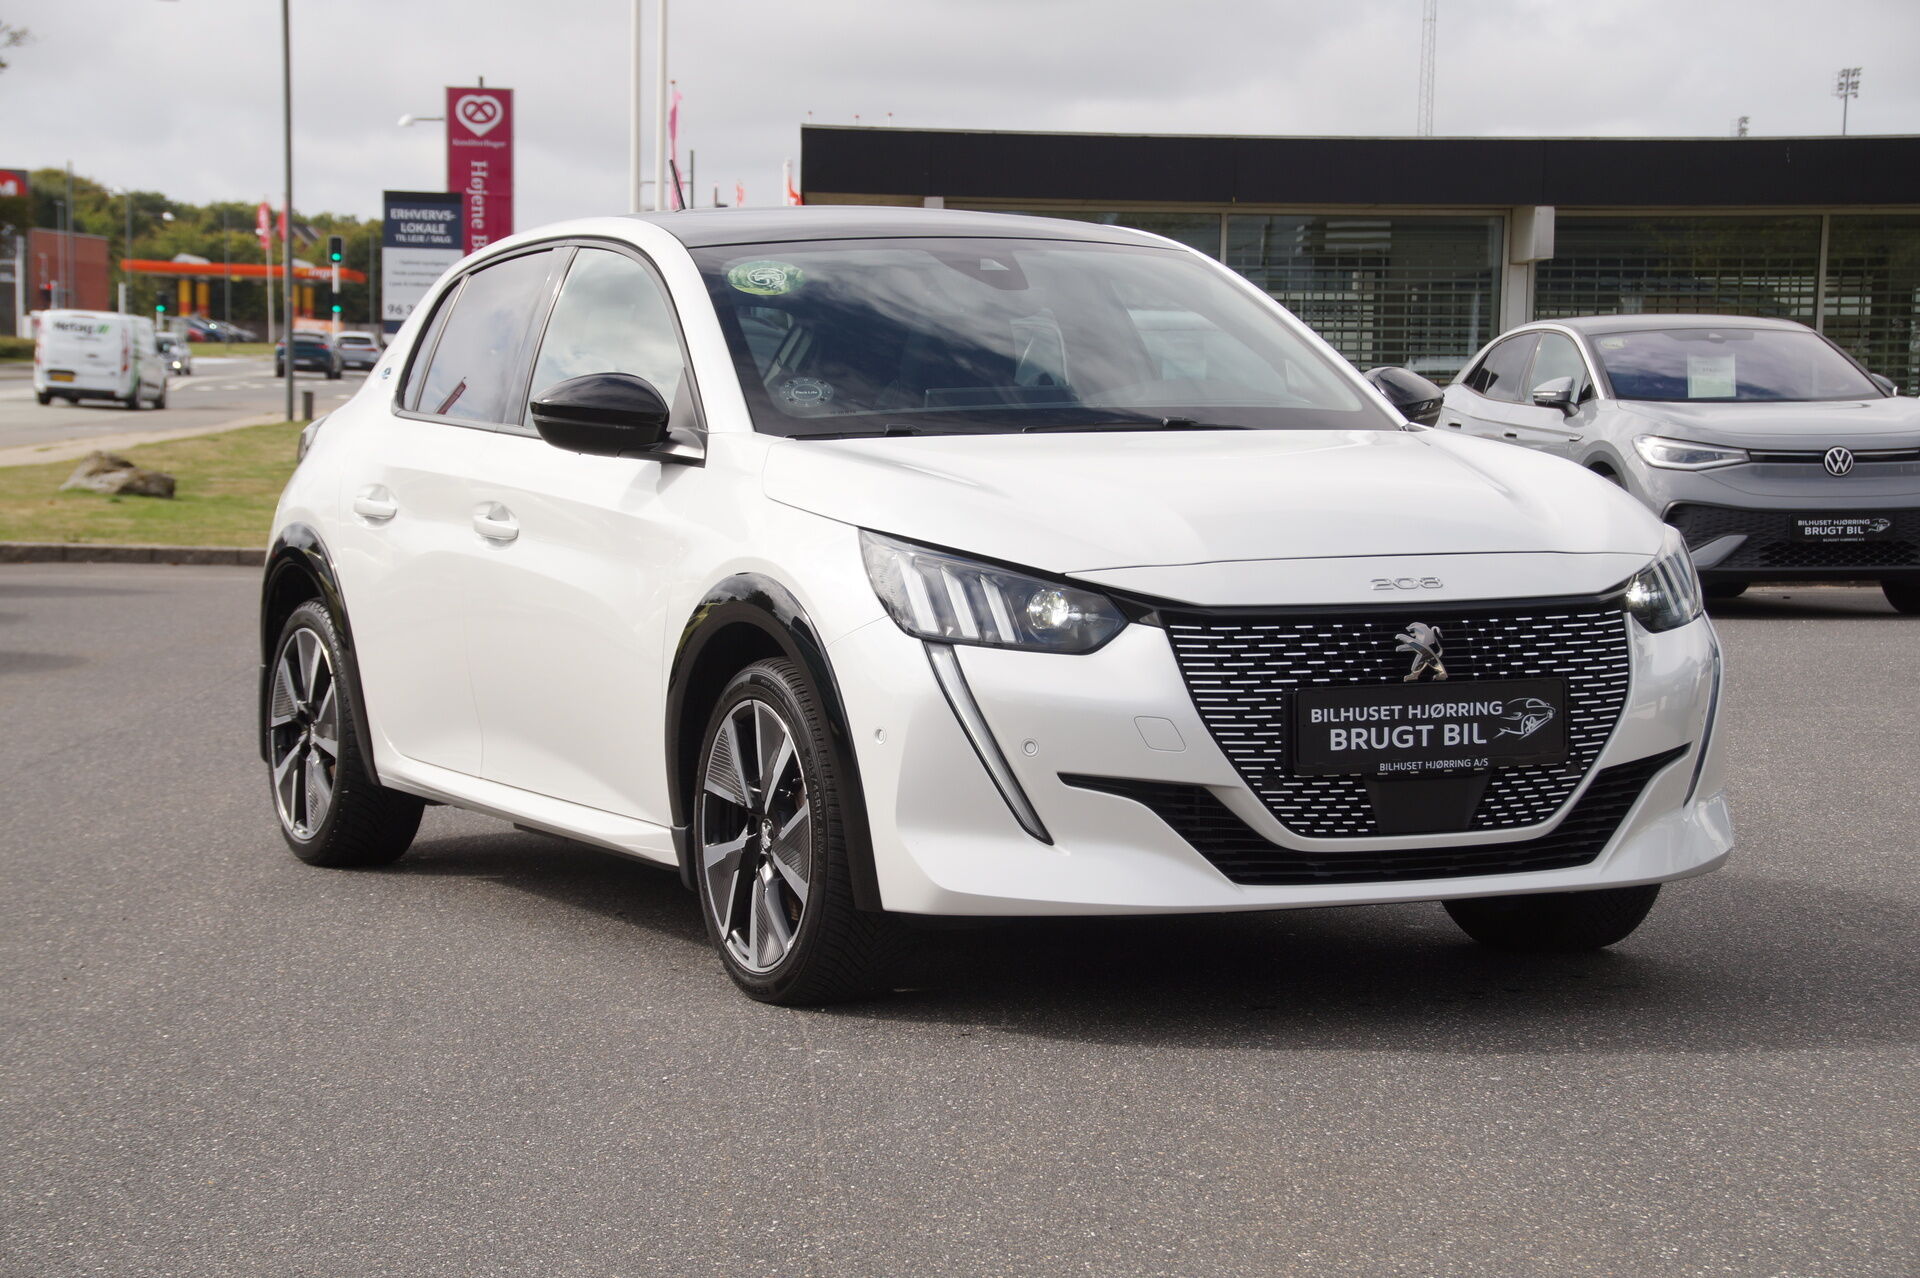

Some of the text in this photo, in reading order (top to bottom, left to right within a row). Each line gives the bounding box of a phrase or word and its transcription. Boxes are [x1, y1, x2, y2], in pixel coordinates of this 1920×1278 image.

[466, 161, 489, 253] Højene B
[390, 208, 457, 221] ERHVERVS-
[400, 222, 446, 234] LOKALE
[1804, 526, 1864, 535] BRUGT BIL
[1370, 576, 1444, 591] 208
[1311, 701, 1503, 723] BILHUSET HJØRRING
[1330, 723, 1487, 752] BRUGT BIL
[1379, 758, 1488, 771] BILHUSET HJØRRING A/S
